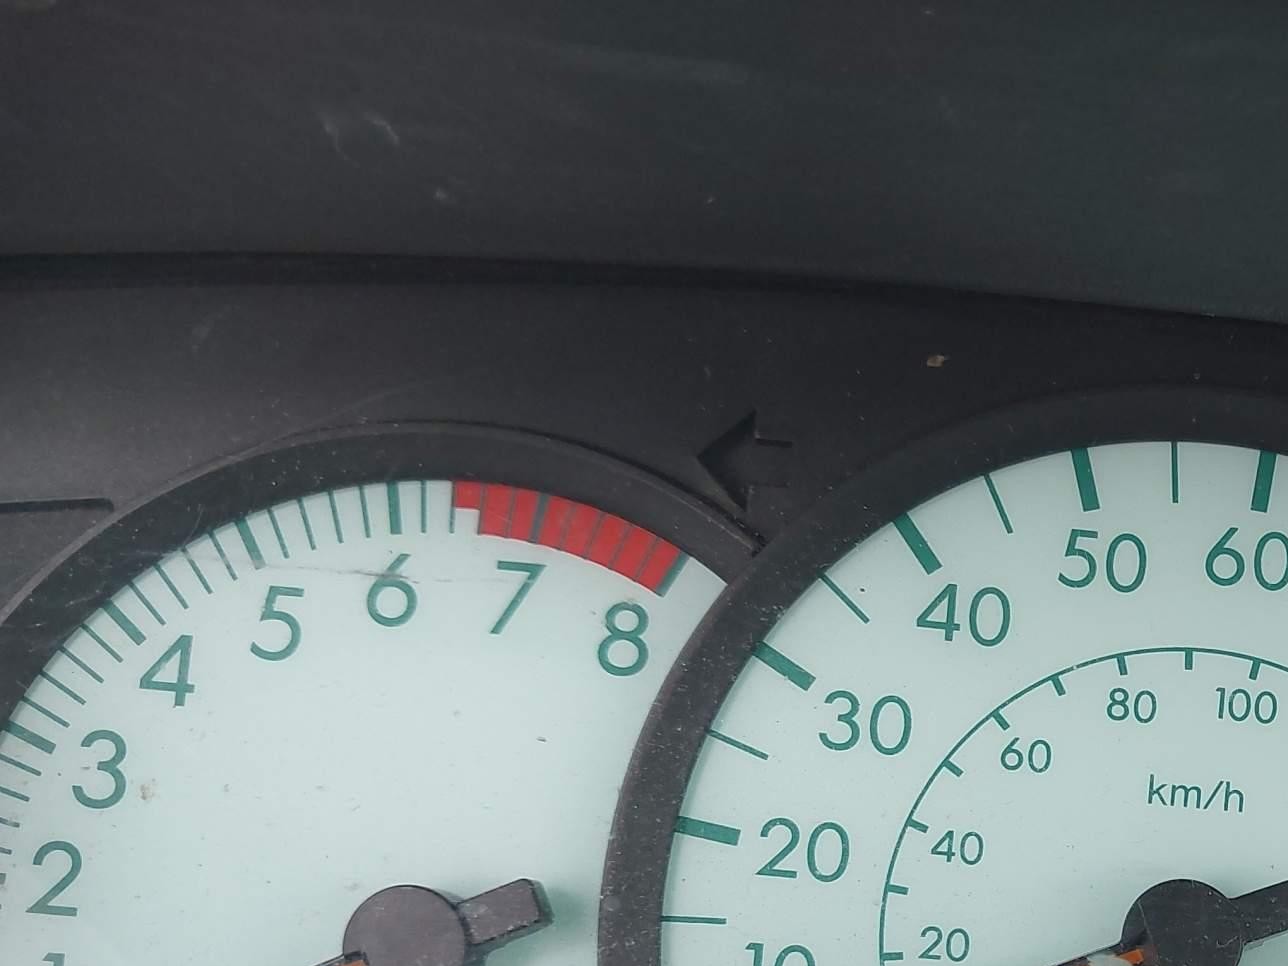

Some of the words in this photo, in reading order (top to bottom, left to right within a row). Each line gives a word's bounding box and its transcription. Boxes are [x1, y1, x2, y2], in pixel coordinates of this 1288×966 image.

[366, 553, 417, 627] 6
[1058, 528, 1148, 593] 50
[250, 585, 305, 662] 5
[489, 561, 546, 635] 7
[916, 583, 1011, 647] 40
[139, 634, 195, 707] 4
[597, 603, 649, 677] 8
[818, 690, 912, 755] 30
[1106, 688, 1157, 723] 80
[1215, 687, 1278, 724] 100
[71, 729, 127, 809] 3
[1000, 738, 1052, 773] 60
[1147, 774, 1245, 812] km/h
[26, 840, 83, 918] 2
[755, 817, 850, 882] 20
[930, 830, 984, 865] 40
[918, 926, 970, 962] 20
